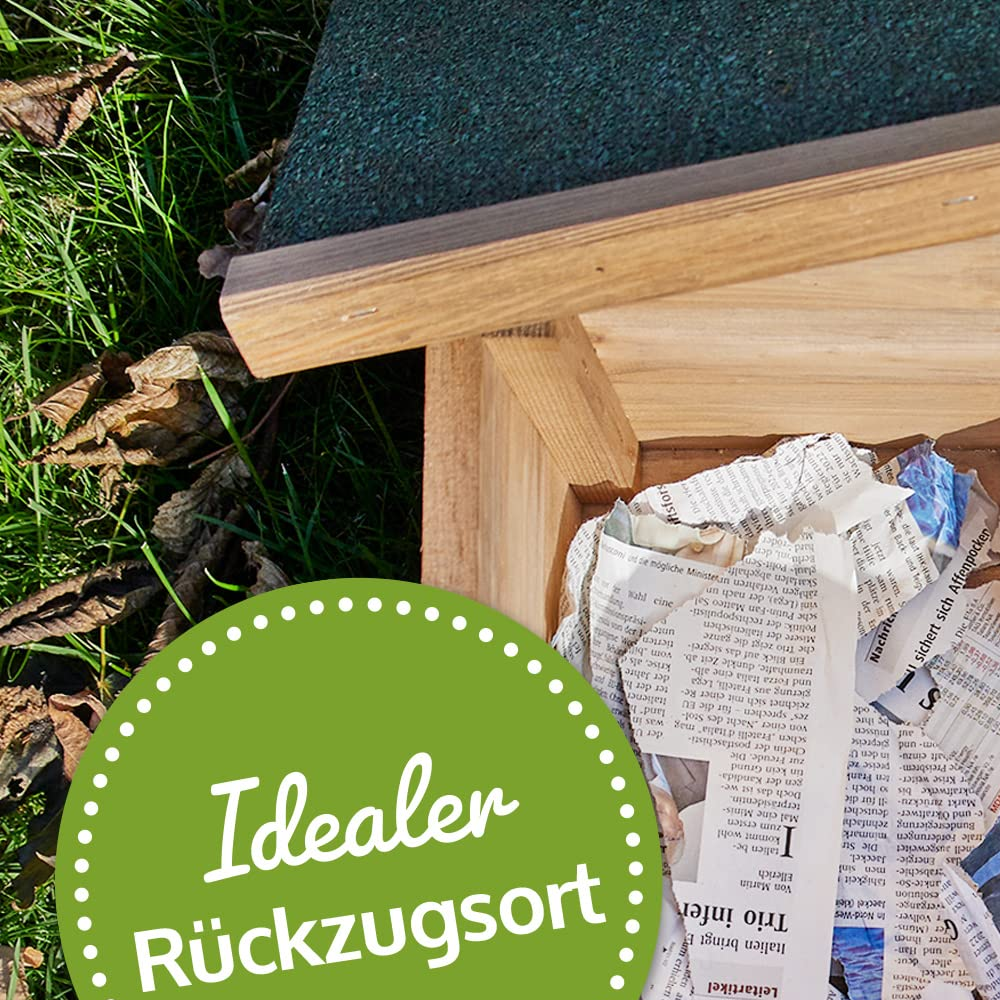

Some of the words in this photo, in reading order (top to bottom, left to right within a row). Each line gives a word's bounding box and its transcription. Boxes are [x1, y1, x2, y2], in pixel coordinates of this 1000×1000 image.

[914, 624, 941, 663] sichert
[936, 597, 954, 622] sich
[948, 528, 994, 595] Affenpocken
[674, 720, 695, 731] mag
[688, 736, 751, 749] postfaschisti-
[779, 734, 807, 744] schen
[754, 743, 770, 753] der
[774, 745, 806, 756] Chefin
[730, 752, 746, 761] Die
[750, 754, 785, 765] Freude.
[731, 763, 762, 773] Grund
[765, 766, 786, 776] kein
[790, 769, 804, 777] tin
[719, 773, 762, 784] Kandida-
[766, 777, 782, 787] der
[785, 778, 803, 787] gen
[757, 788, 773, 797] das
[776, 790, 801, 800] Doch
[731, 796, 800, 811] terpräsidentin.
[723, 807, 753, 818] Minis-
[756, 810, 778, 819] eine
[780, 813, 799, 823] Mal
[727, 819, 757, 828] ersten
[760, 823, 781, 831] zum
[717, 829, 742, 839] wohl
[745, 833, 780, 845] kommt
[758, 870, 793, 882] Ellerich
[740, 880, 771, 891] Martin
[774, 883, 792, 894] Von
[744, 910, 788, 933] Trio
[700, 932, 739, 952] bringt
[745, 940, 785, 955] Italien
[708, 982, 778, 998] Leitartikel
